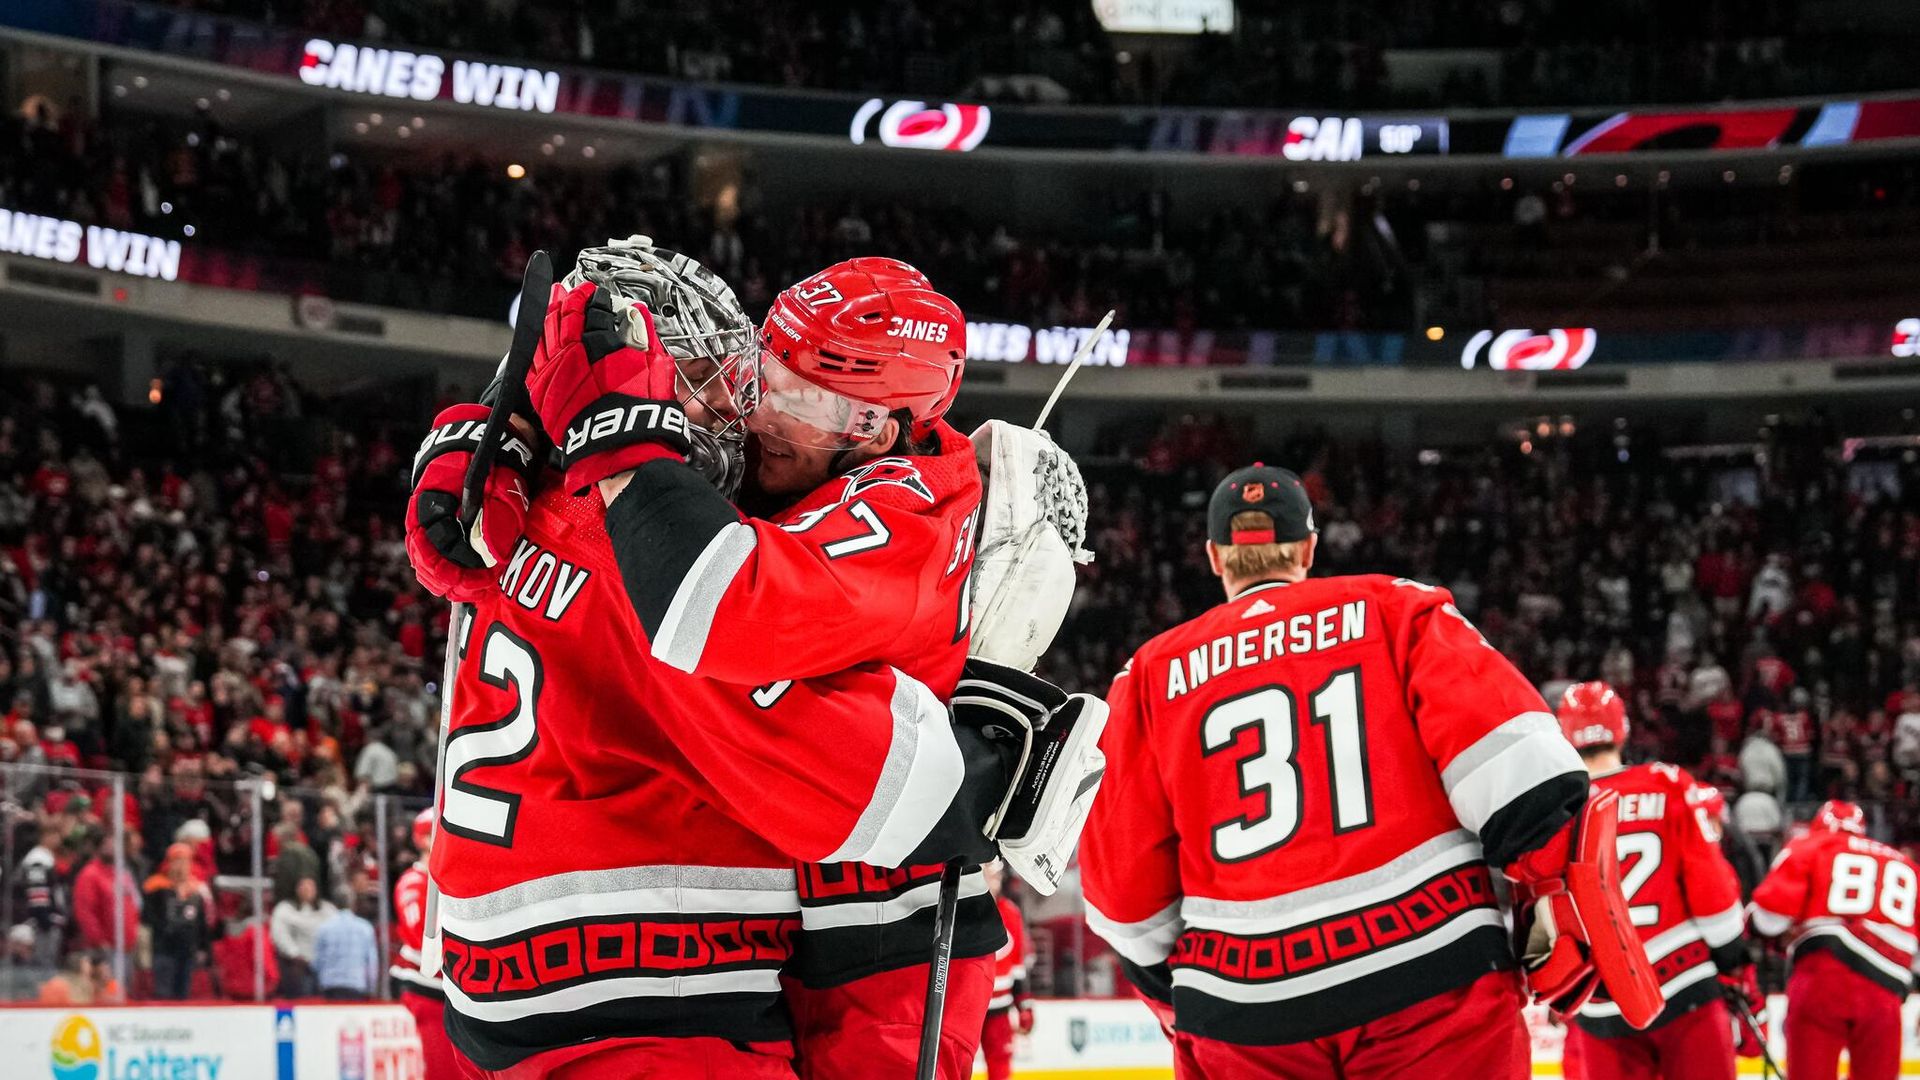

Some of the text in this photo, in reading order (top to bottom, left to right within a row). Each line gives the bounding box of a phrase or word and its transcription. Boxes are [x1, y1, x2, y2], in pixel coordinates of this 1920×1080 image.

[299, 38, 560, 113] CANES WIN
[87, 225, 181, 281] WIN
[800, 281, 844, 307] 37
[771, 313, 803, 343] BAUER
[886, 317, 948, 343] CANES
[1166, 599, 1367, 701] ANDERSEN
[1200, 664, 1375, 864] 31
[1033, 853, 1061, 888] TRUE
[1827, 852, 1918, 927] 88
[934, 955, 947, 994] KOCHETKOV
[107, 1047, 222, 1080] Lottery
